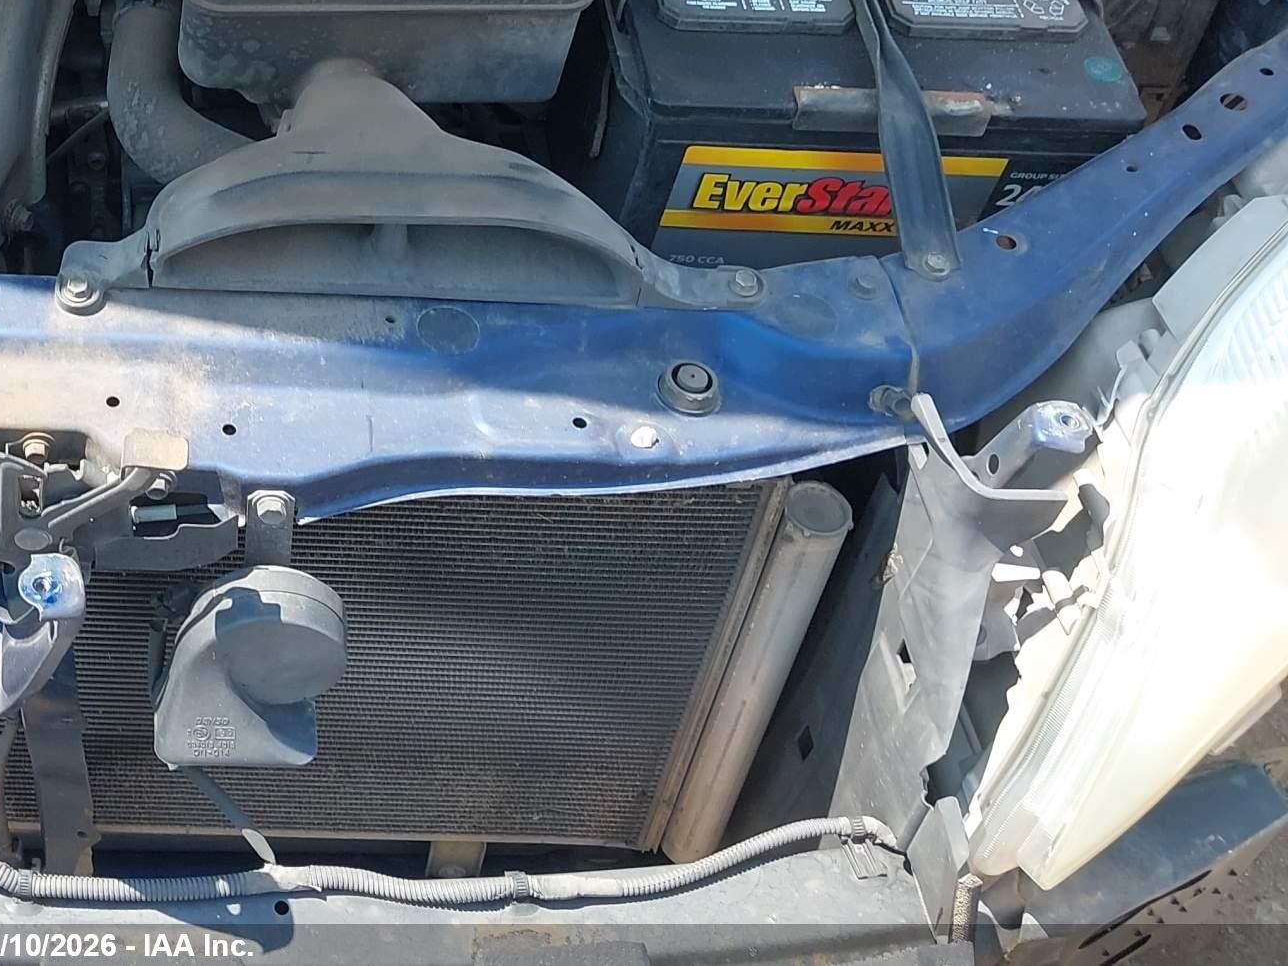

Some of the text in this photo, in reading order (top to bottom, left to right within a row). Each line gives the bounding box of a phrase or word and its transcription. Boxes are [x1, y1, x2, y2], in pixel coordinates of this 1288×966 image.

[1010, 172, 1048, 180] GROUP
[693, 173, 892, 216] EverSta
[830, 220, 895, 233] MAXX
[670, 255, 725, 264] 750 CCA
